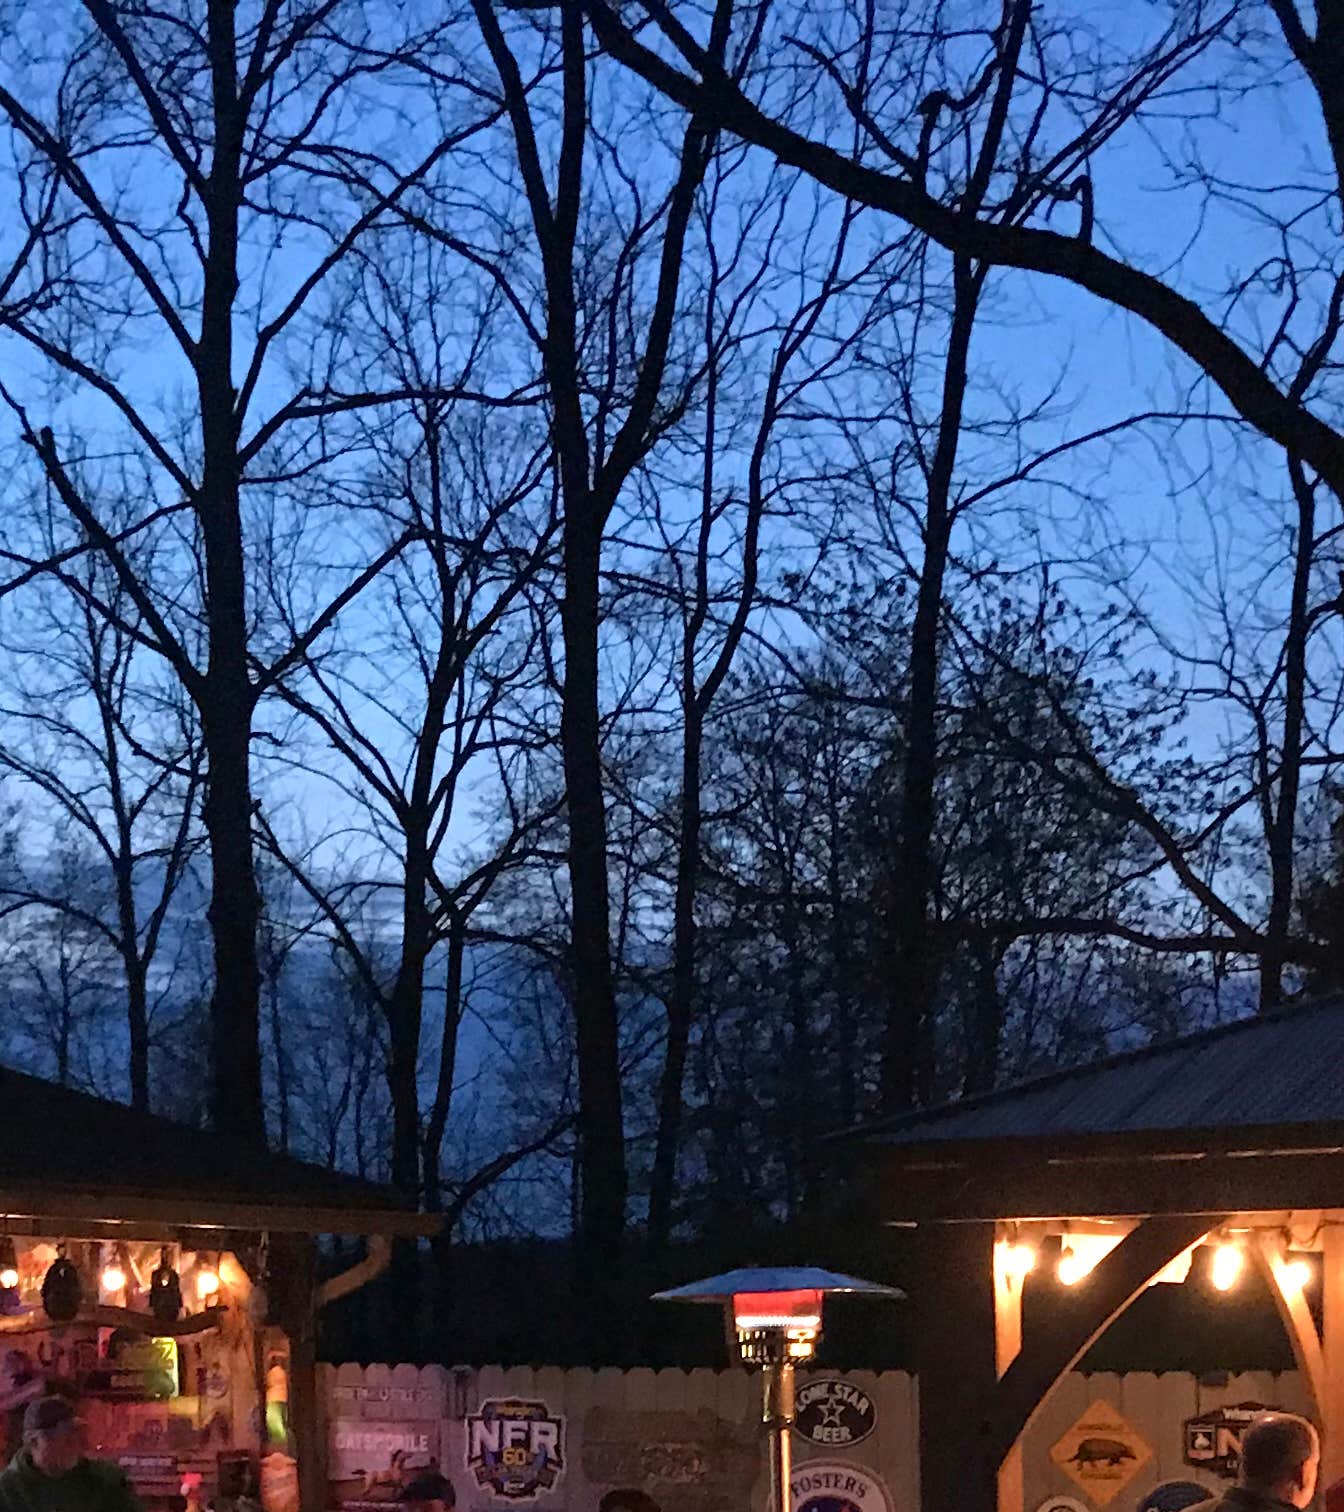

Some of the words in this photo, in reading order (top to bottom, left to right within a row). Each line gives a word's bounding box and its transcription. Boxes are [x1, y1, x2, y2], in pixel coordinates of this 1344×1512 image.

[833, 1383, 870, 1416] STAR
[471, 1419, 560, 1462] NFR
[812, 1425, 853, 1442] BEER
